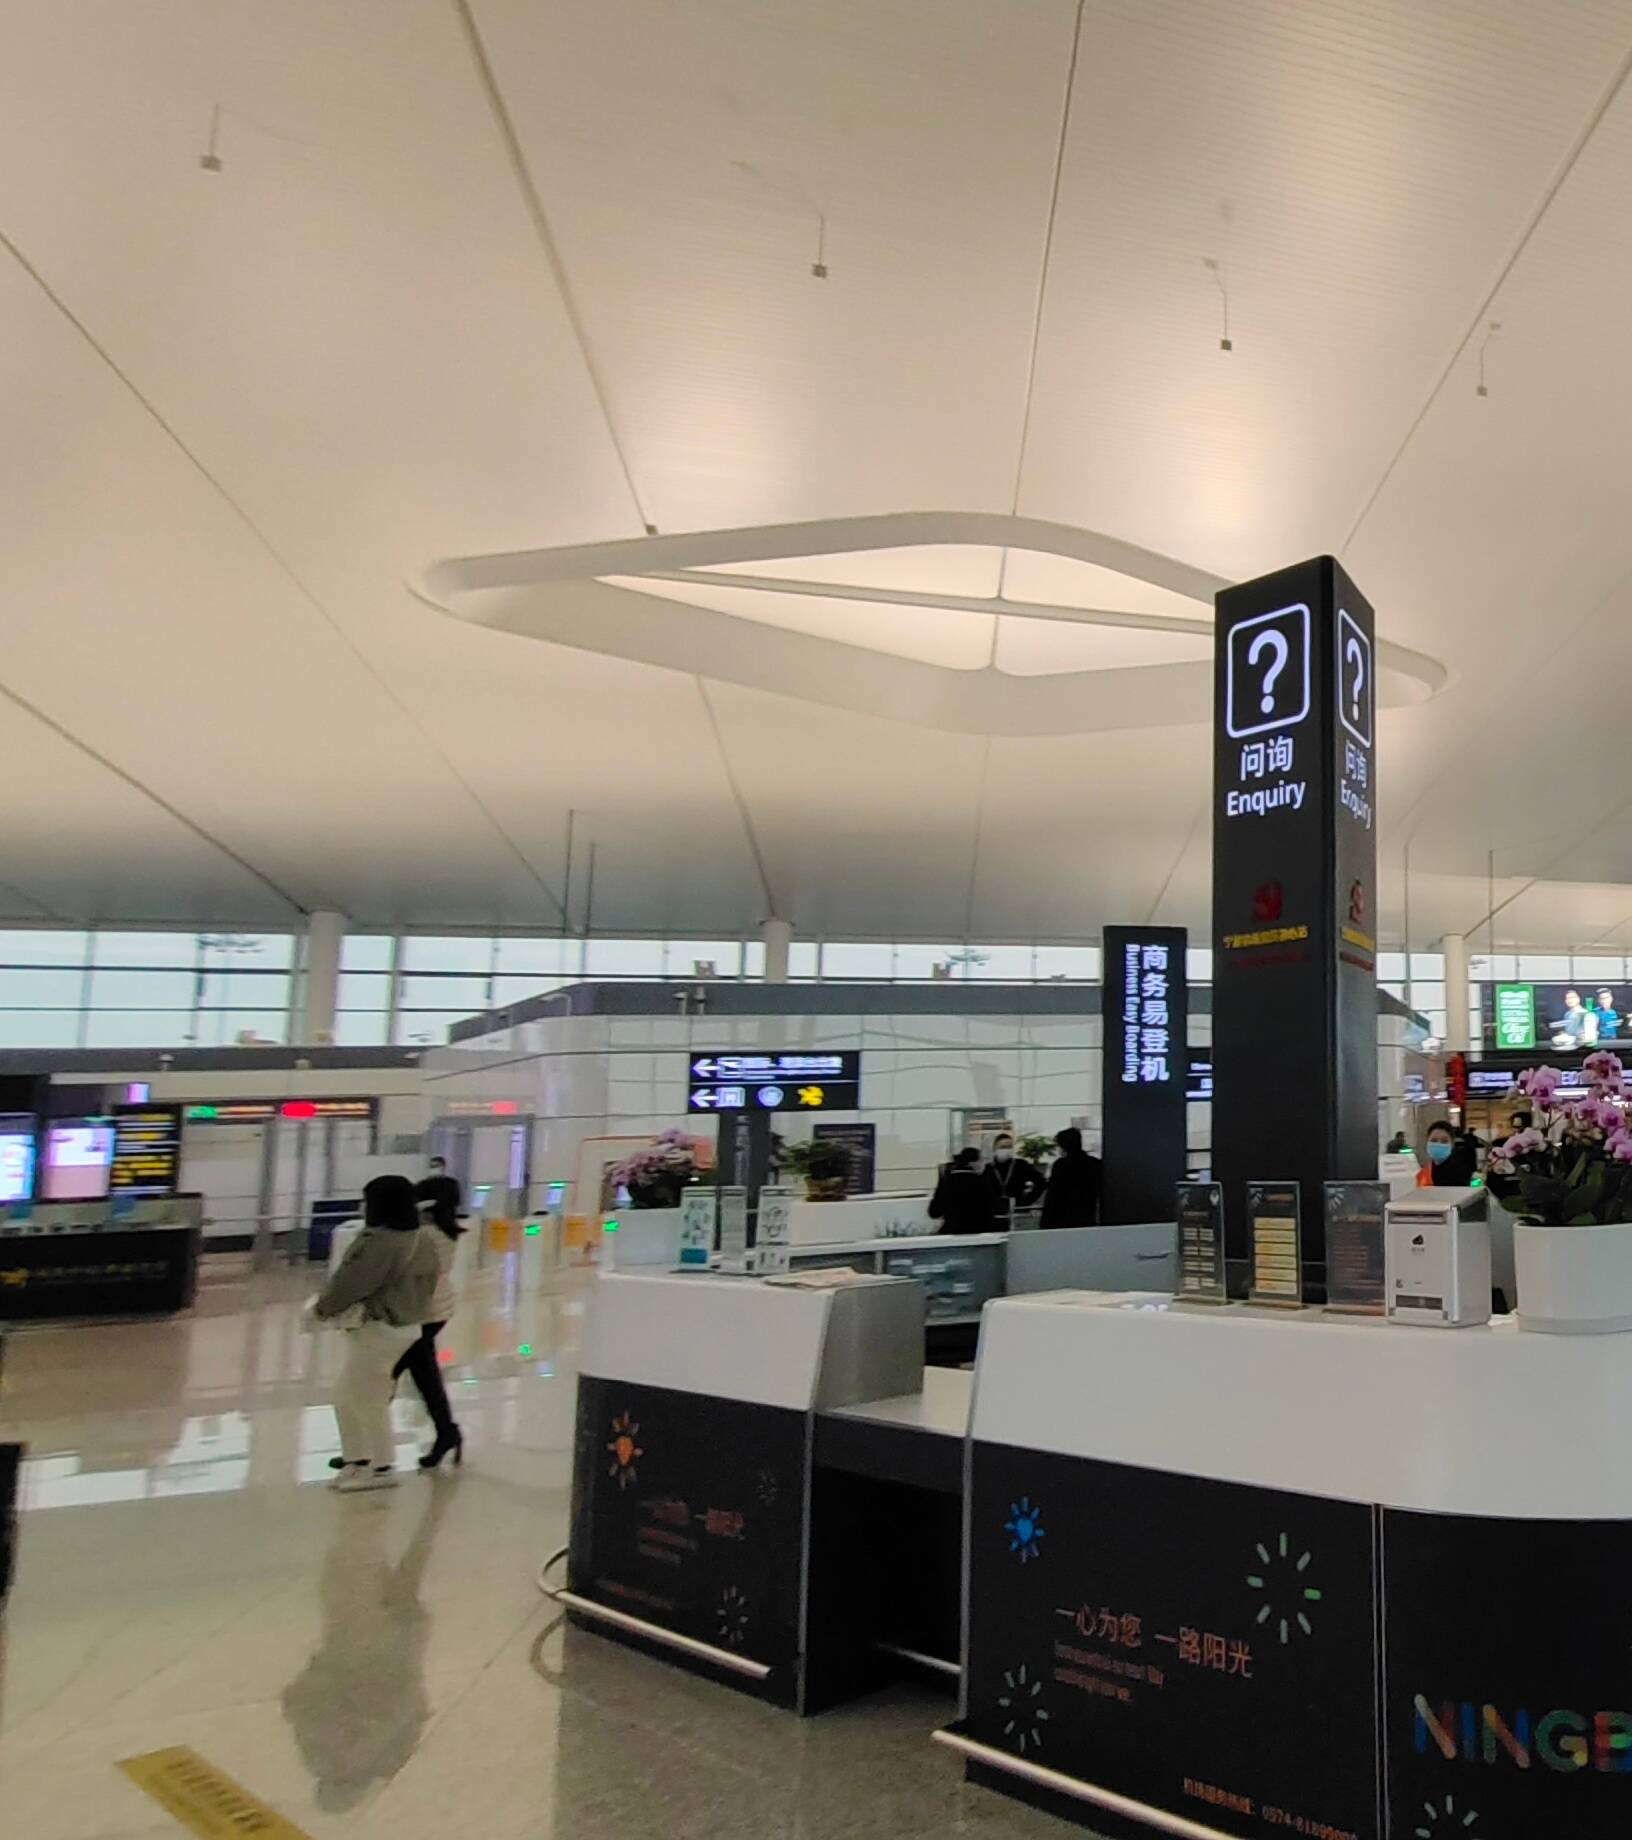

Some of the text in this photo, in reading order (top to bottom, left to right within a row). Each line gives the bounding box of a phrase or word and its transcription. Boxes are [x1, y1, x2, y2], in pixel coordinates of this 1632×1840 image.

[1240, 735, 1294, 781] 问询
[1344, 739, 1368, 789] 问询
[1227, 779, 1306, 817] Enquiry
[1340, 778, 1372, 829] Enquiry
[1121, 943, 1141, 1083] Business Easy Boarding
[1140, 944, 1170, 1082] 商务易登机
[1055, 1603, 1142, 1648] 一心为您
[1154, 1626, 1253, 1678] 一路阳光
